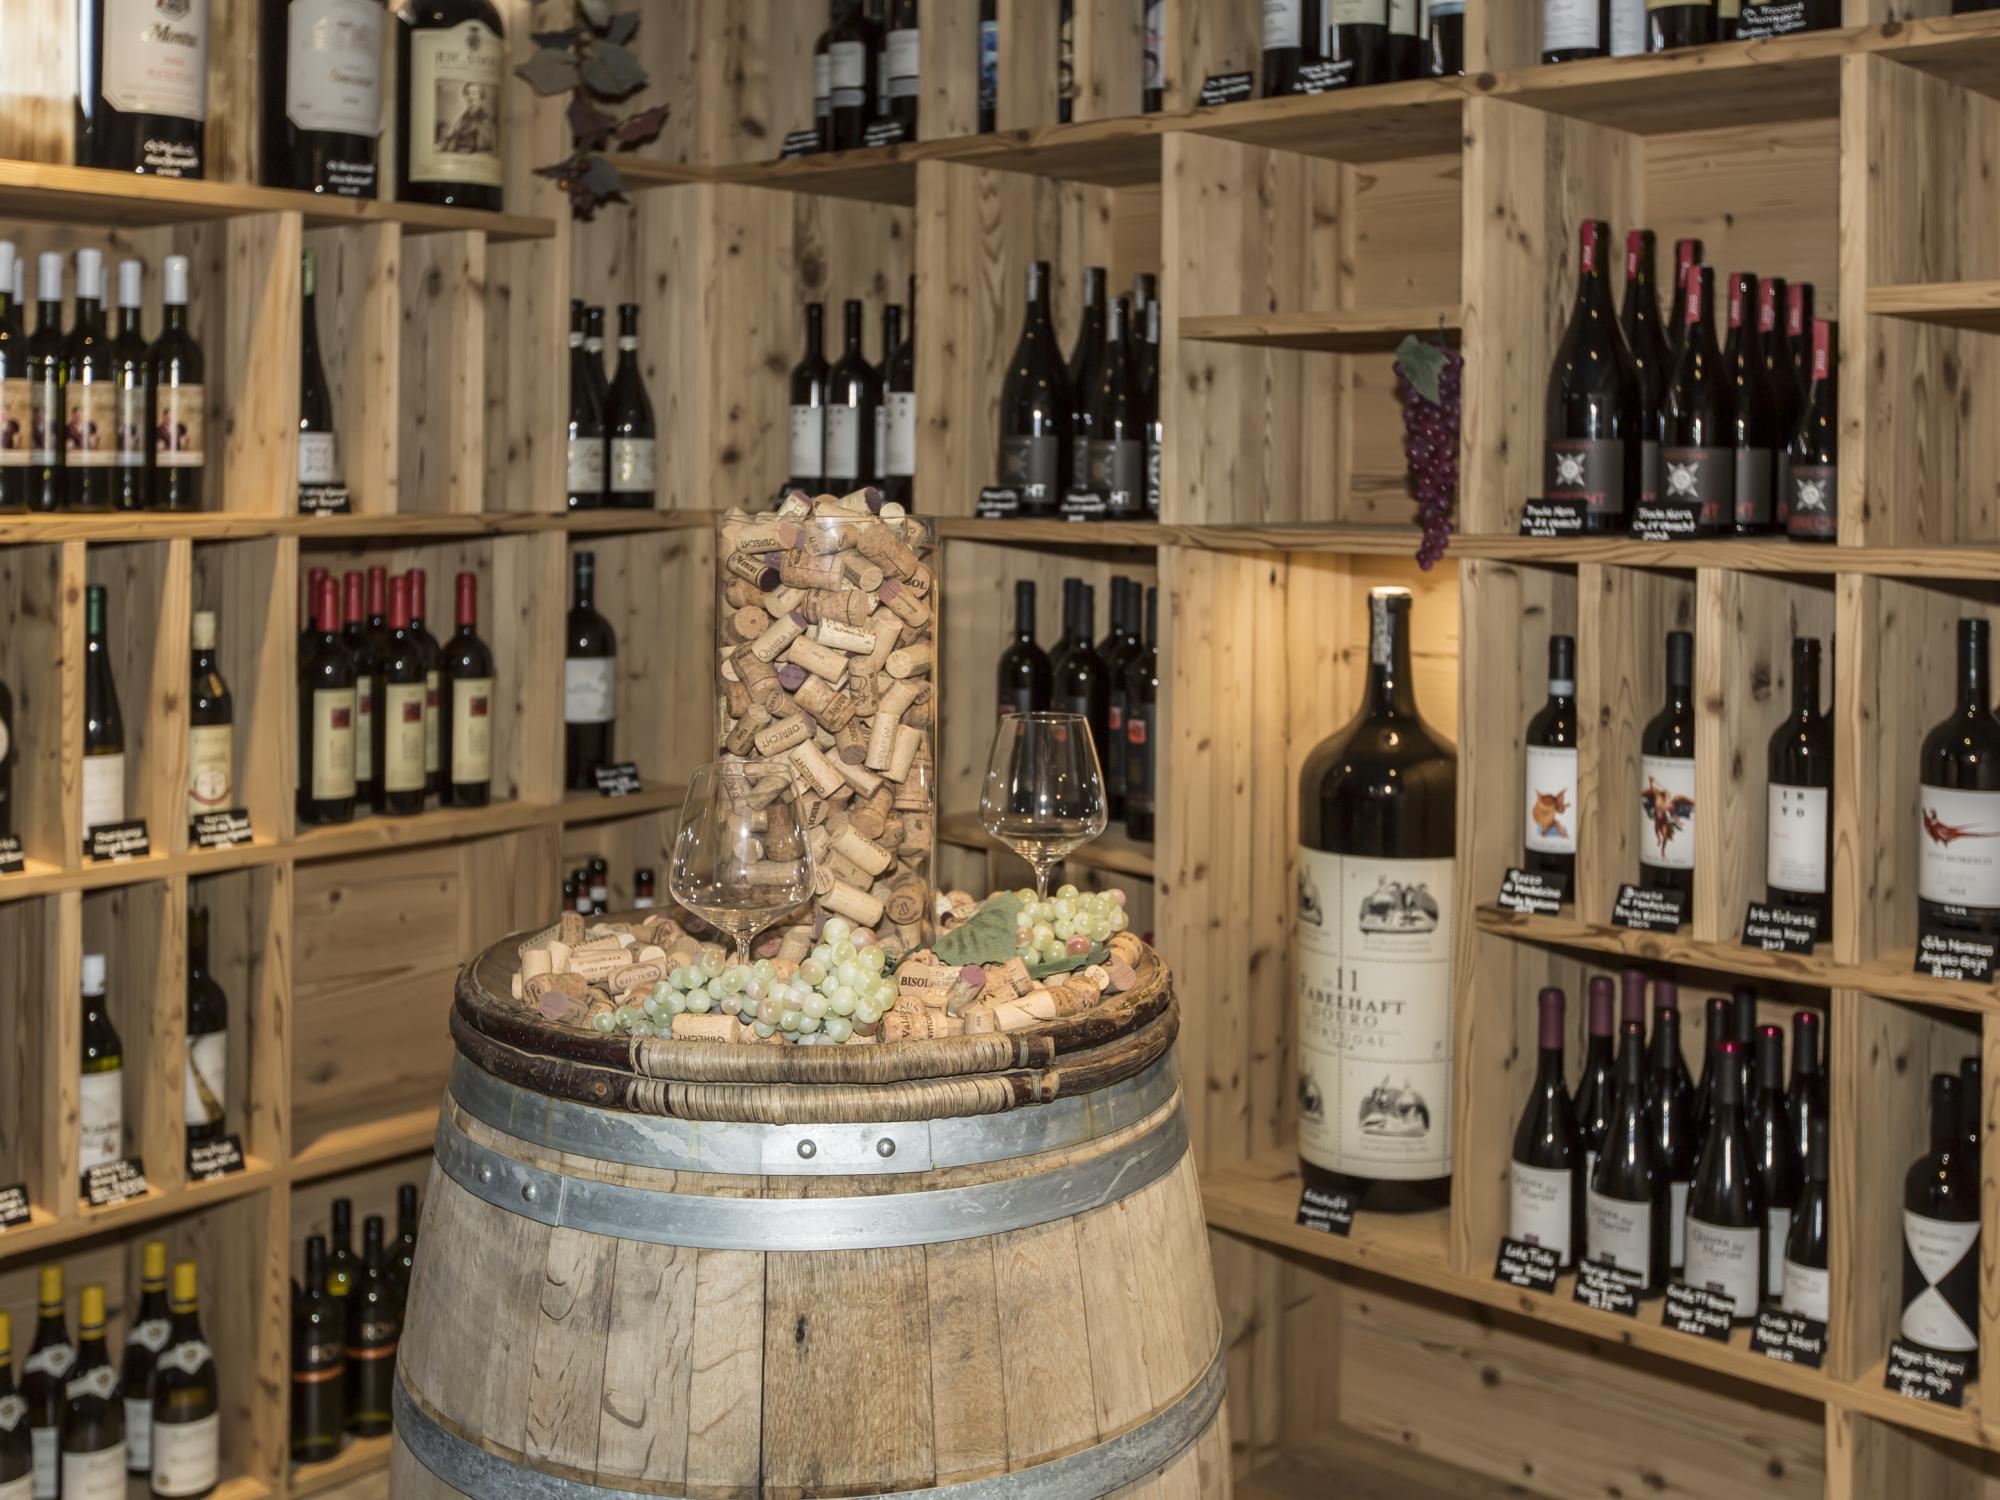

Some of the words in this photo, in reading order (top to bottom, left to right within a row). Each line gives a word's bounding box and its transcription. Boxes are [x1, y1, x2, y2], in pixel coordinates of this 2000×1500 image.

[758, 634, 788, 658] Quinta
[762, 723, 801, 748] OBRECHT
[900, 976, 930, 988] BISOL
[679, 1034, 725, 1043] OBRECHT
